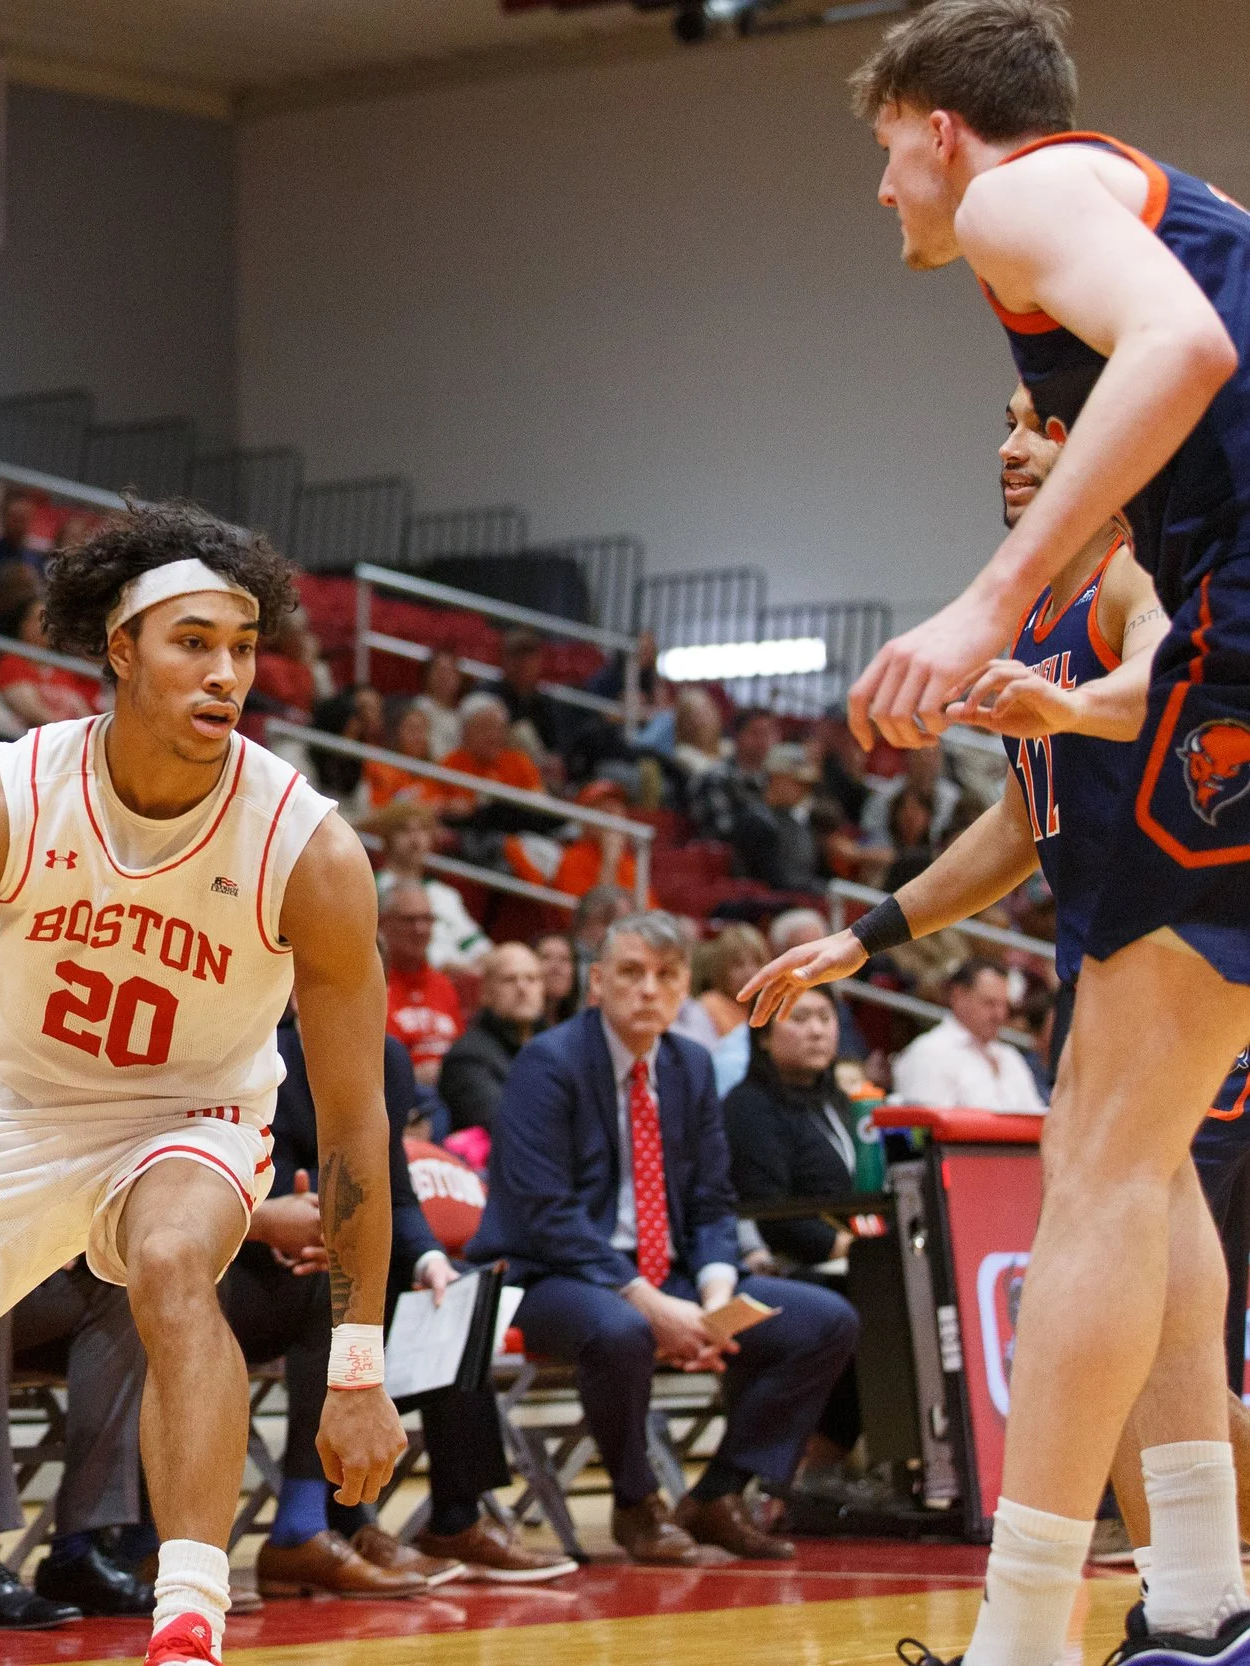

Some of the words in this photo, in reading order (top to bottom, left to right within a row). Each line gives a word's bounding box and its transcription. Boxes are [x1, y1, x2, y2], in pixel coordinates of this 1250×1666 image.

[1016, 733, 1060, 842] 12
[25, 900, 233, 985] BOSTON
[41, 960, 180, 1067] 20
